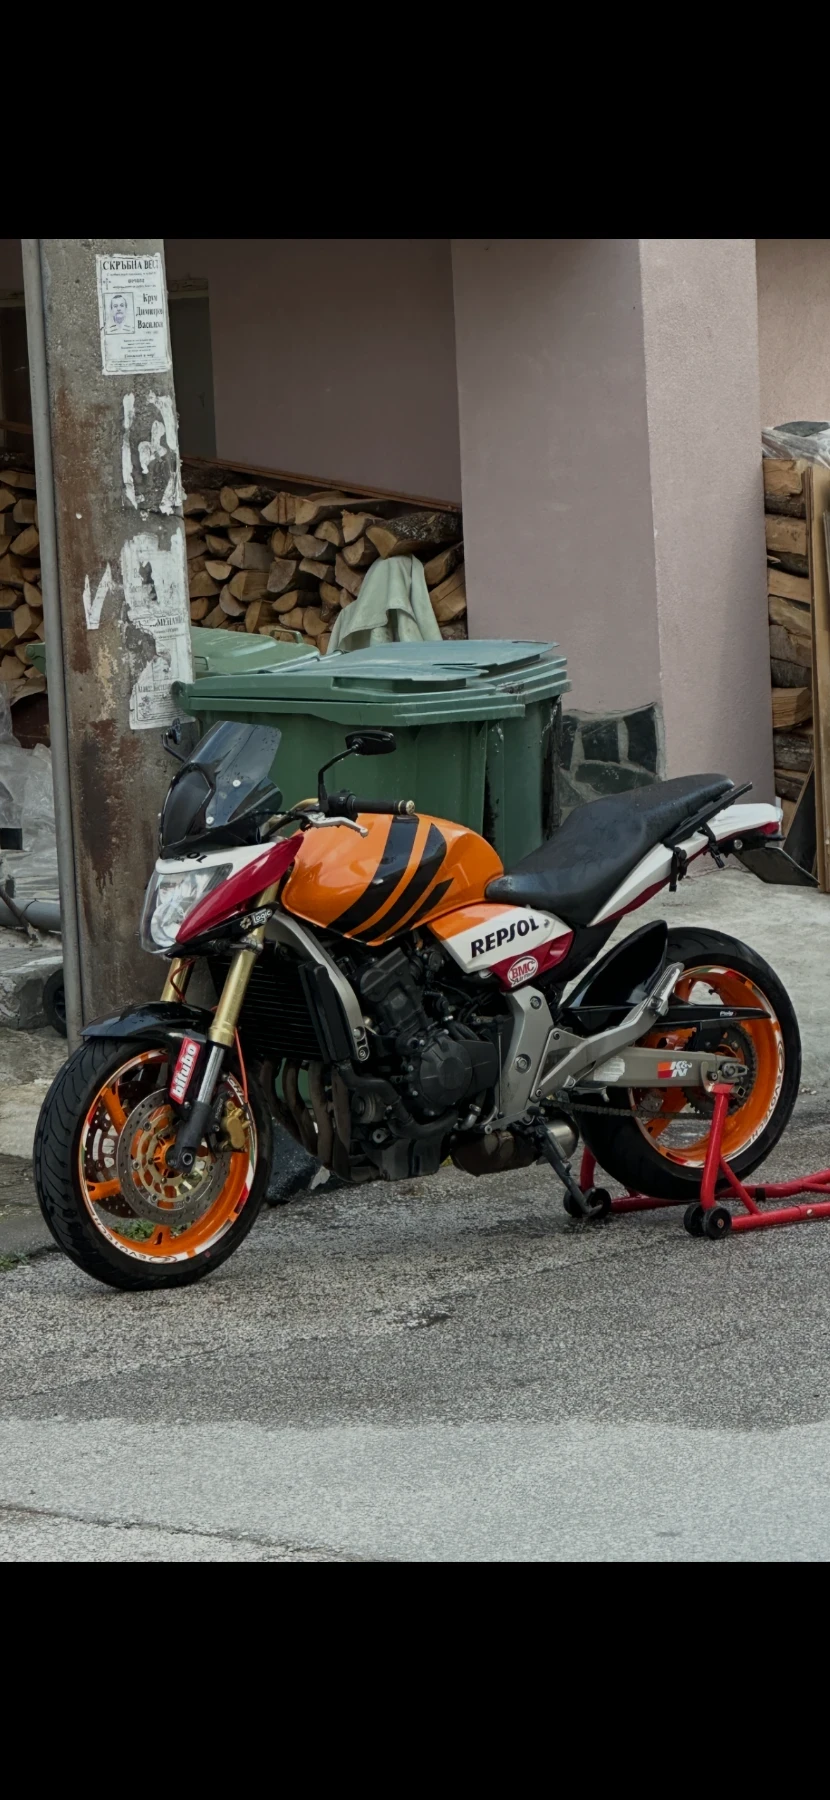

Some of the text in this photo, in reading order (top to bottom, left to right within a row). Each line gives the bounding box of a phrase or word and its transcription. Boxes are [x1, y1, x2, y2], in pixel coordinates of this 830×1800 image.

[102, 260, 143, 271] СКРЪБНА
[470, 917, 539, 958] REPSOL
[511, 960, 535, 979] BMC
[172, 1043, 198, 1098] bitubo
